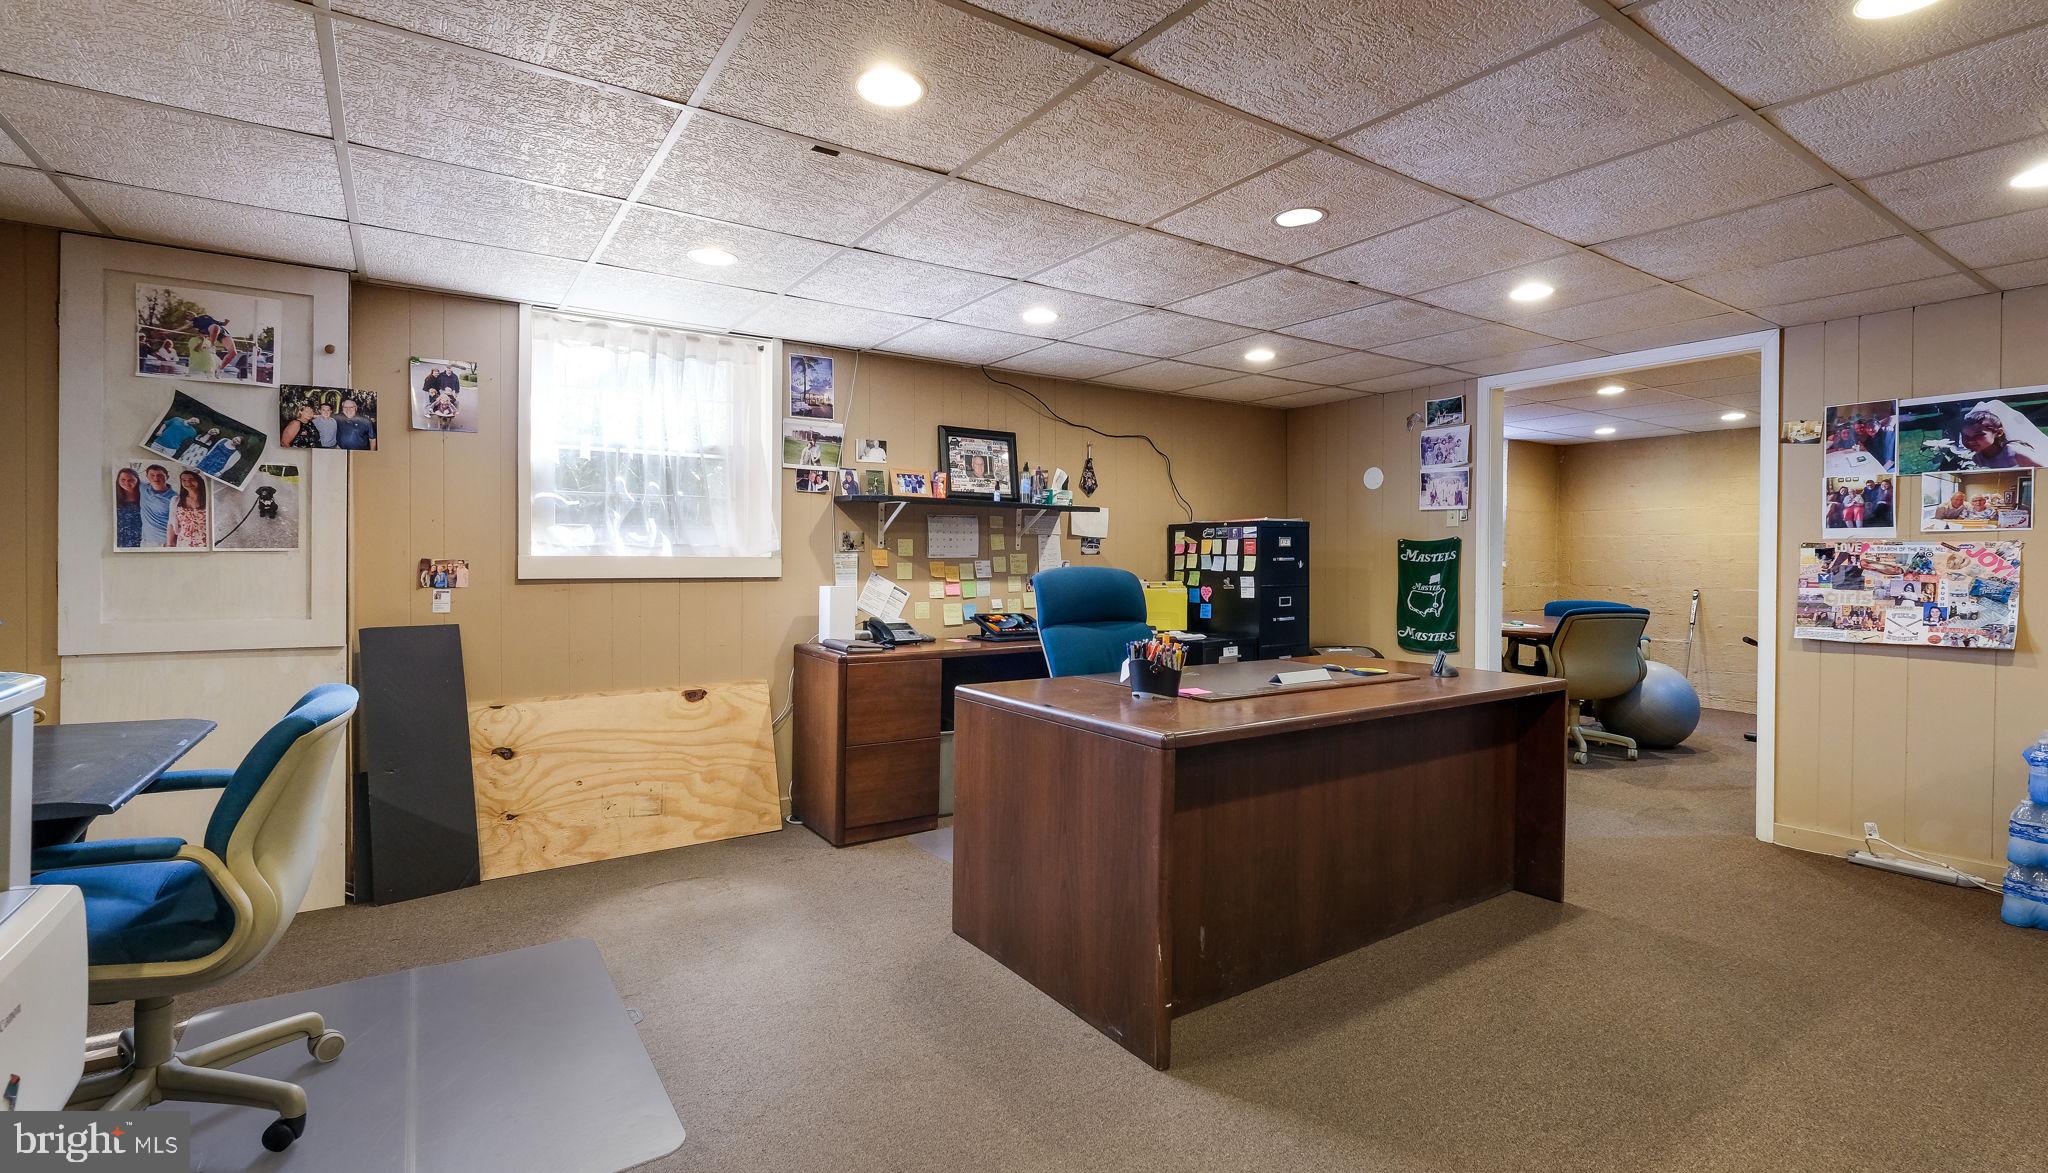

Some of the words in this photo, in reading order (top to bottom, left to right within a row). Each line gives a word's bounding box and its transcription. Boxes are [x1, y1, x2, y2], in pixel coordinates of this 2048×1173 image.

[1876, 544, 1898, 552] SEARCH
[1899, 544, 1906, 552] OF
[1398, 627, 1456, 641] MASTERS
